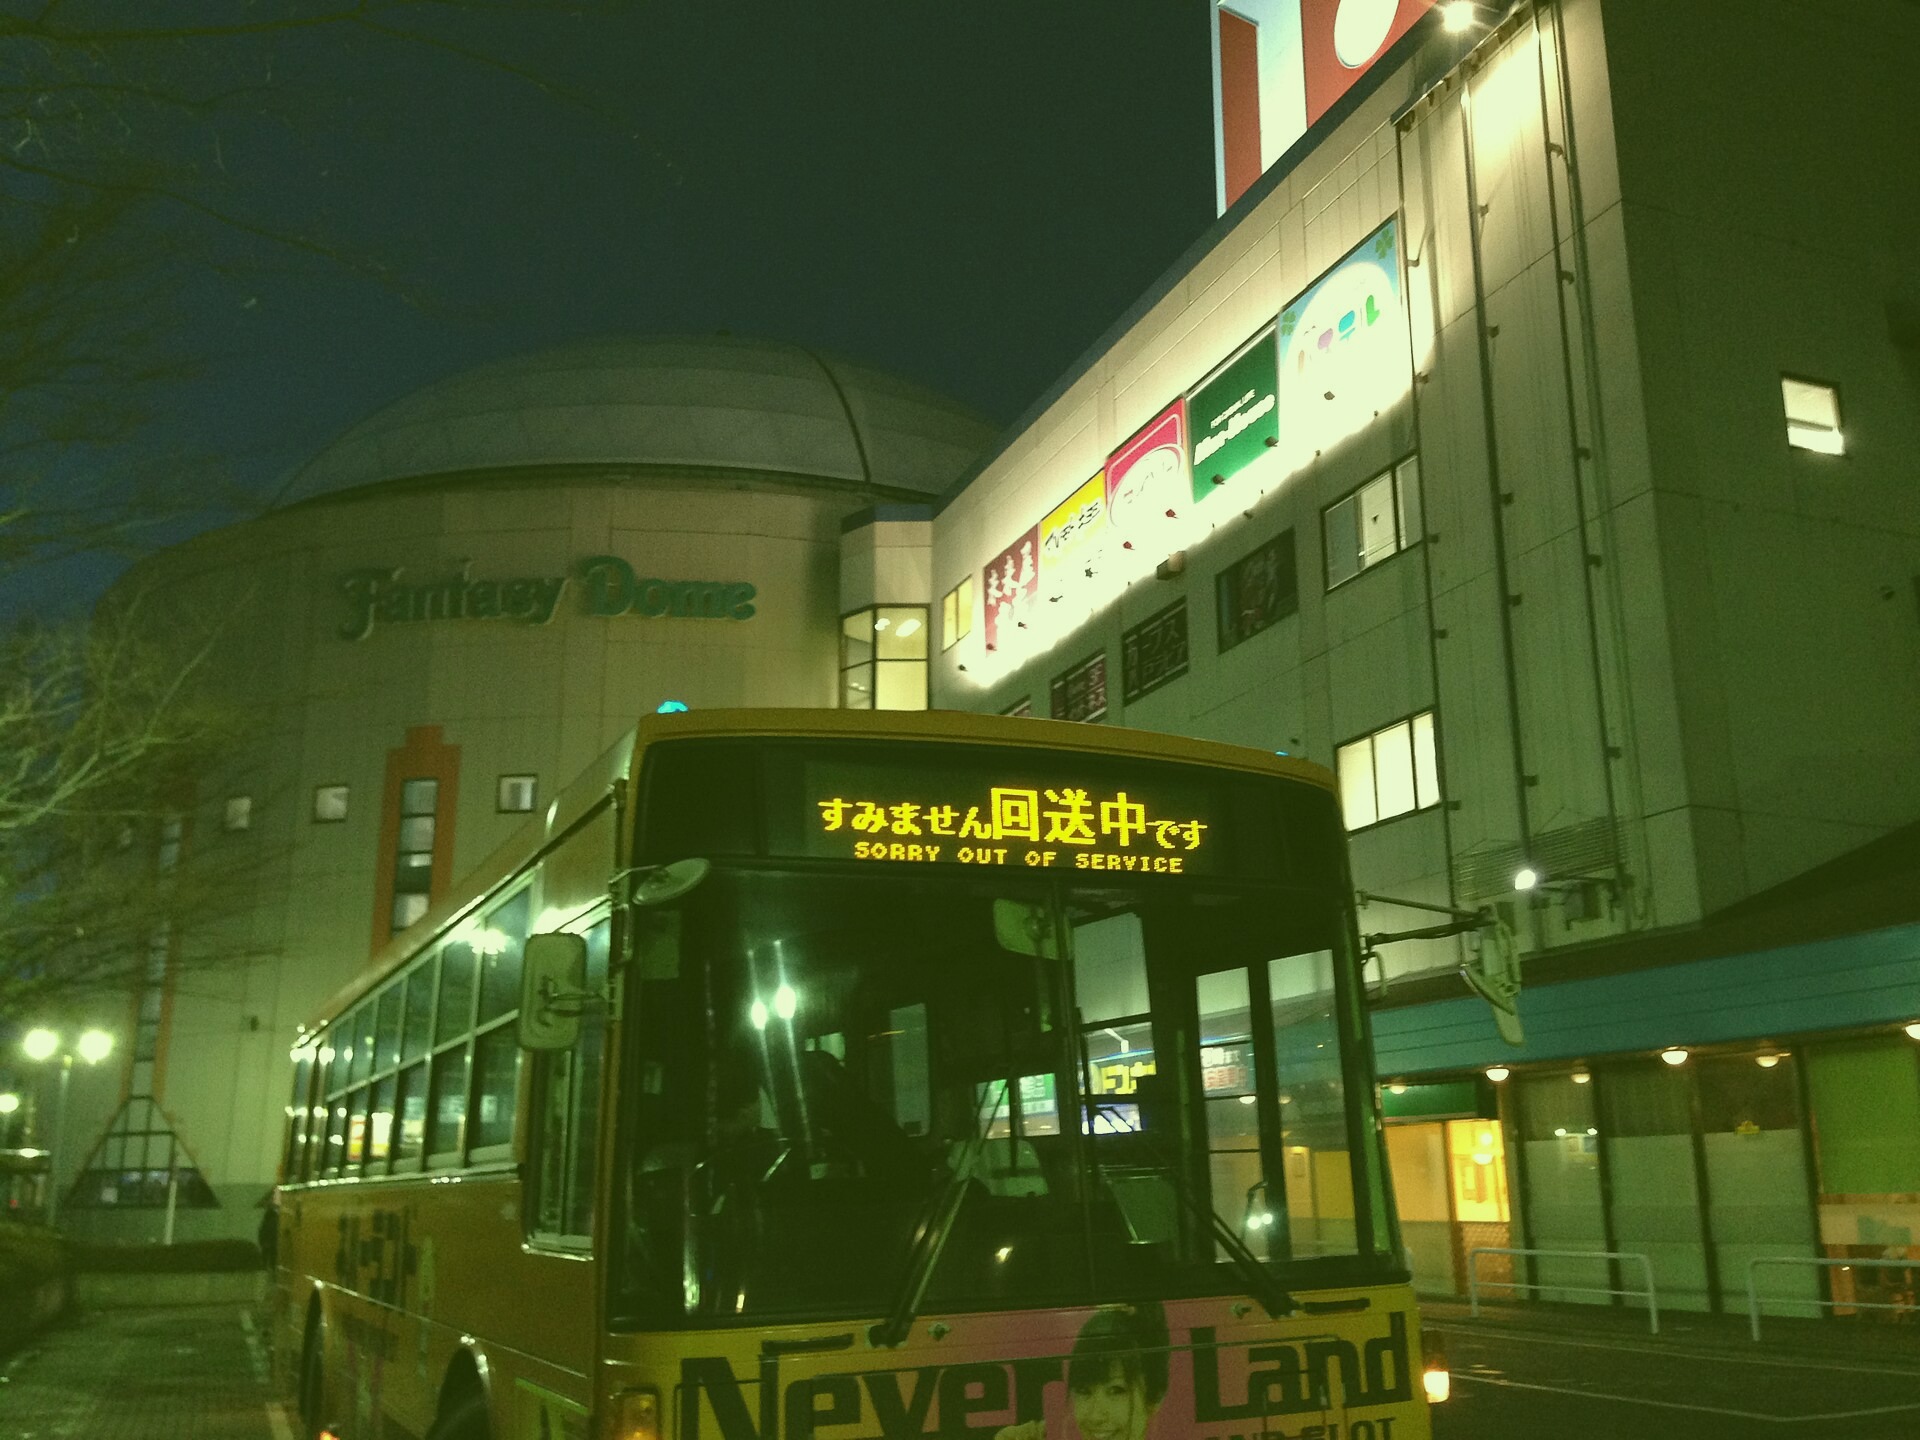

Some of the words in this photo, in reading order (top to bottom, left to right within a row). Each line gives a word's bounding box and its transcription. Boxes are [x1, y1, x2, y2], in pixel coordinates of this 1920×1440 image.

[577, 555, 756, 621] Dome
[818, 786, 1208, 850] すみません回送中です
[854, 841, 941, 862] SORRY
[957, 847, 1008, 866] OUT
[1024, 850, 1057, 868] OF
[1075, 852, 1184, 874] SERVICE
[680, 1353, 1069, 1440] Never
[1190, 1311, 1413, 1423] Land
